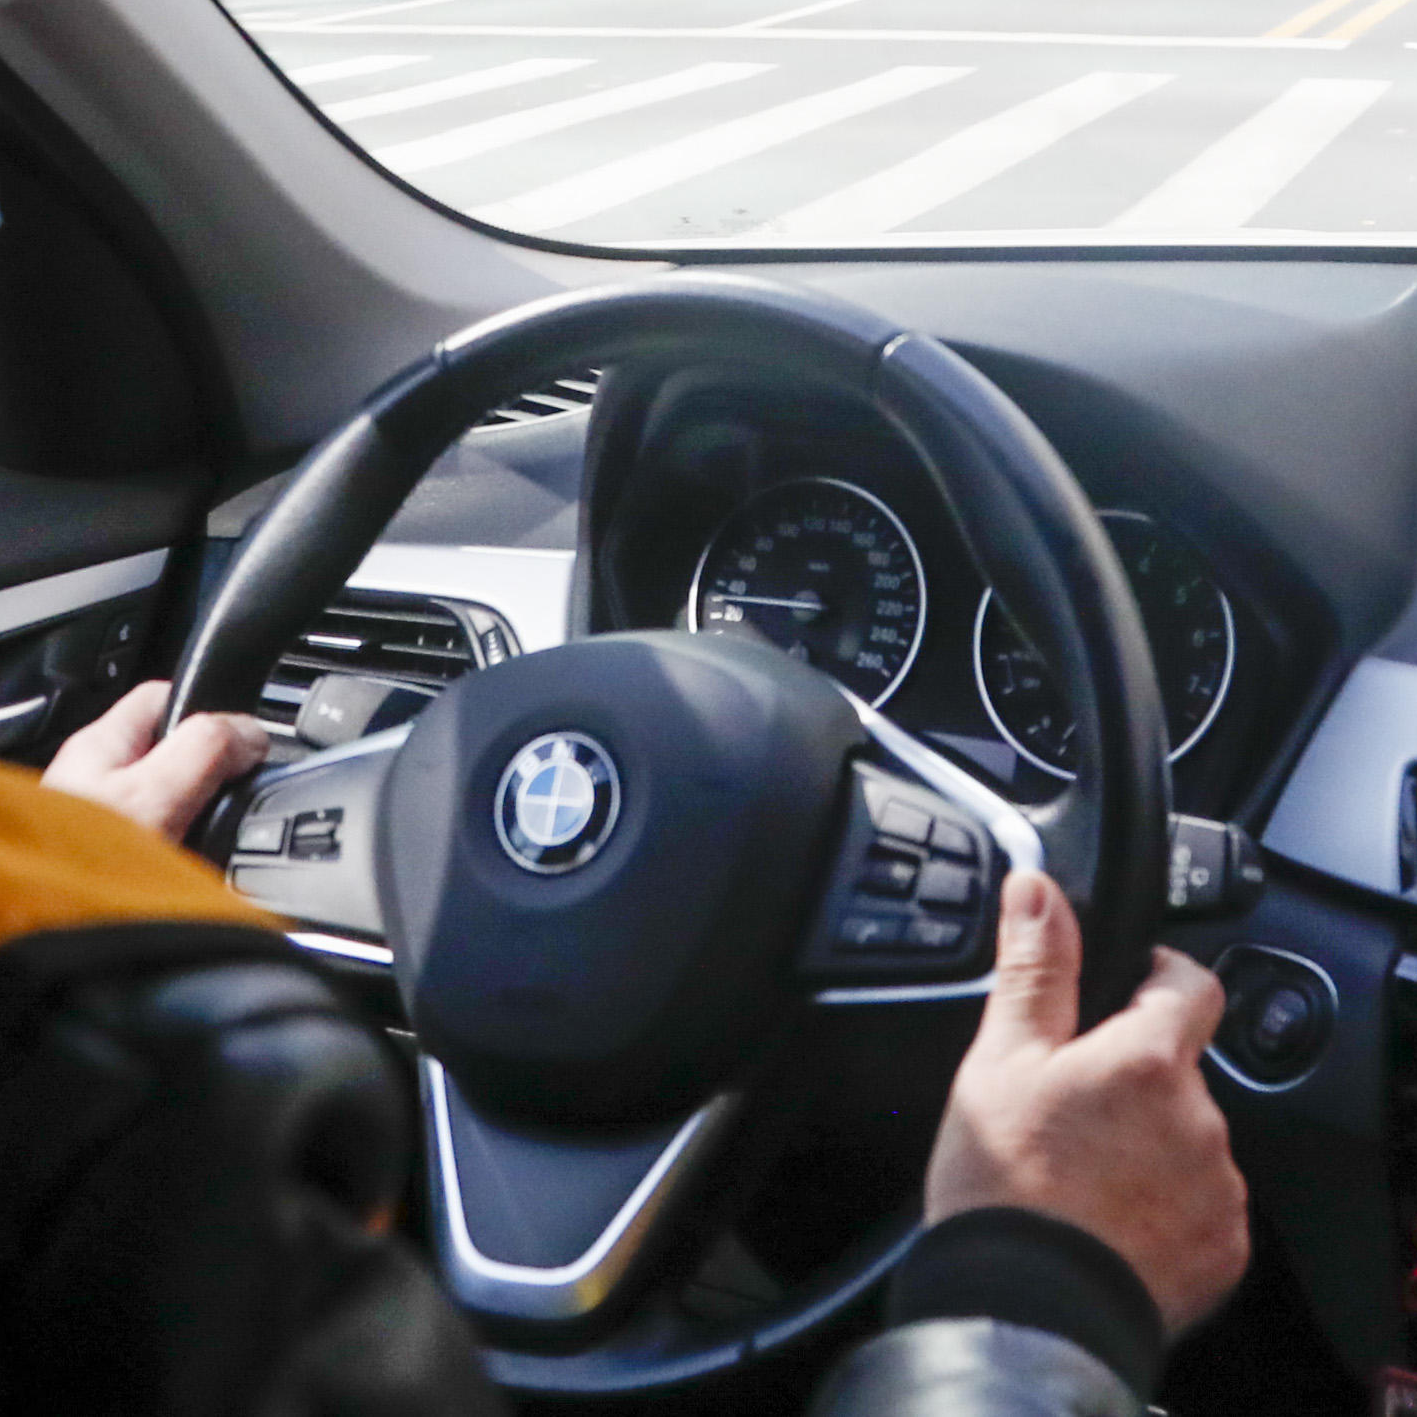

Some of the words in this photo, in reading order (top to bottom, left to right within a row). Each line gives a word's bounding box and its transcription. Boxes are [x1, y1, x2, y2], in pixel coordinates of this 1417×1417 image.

[873, 571, 901, 591] 200
[875, 599, 904, 618] 220
[870, 624, 899, 643] 240
[856, 651, 885, 670] 260
